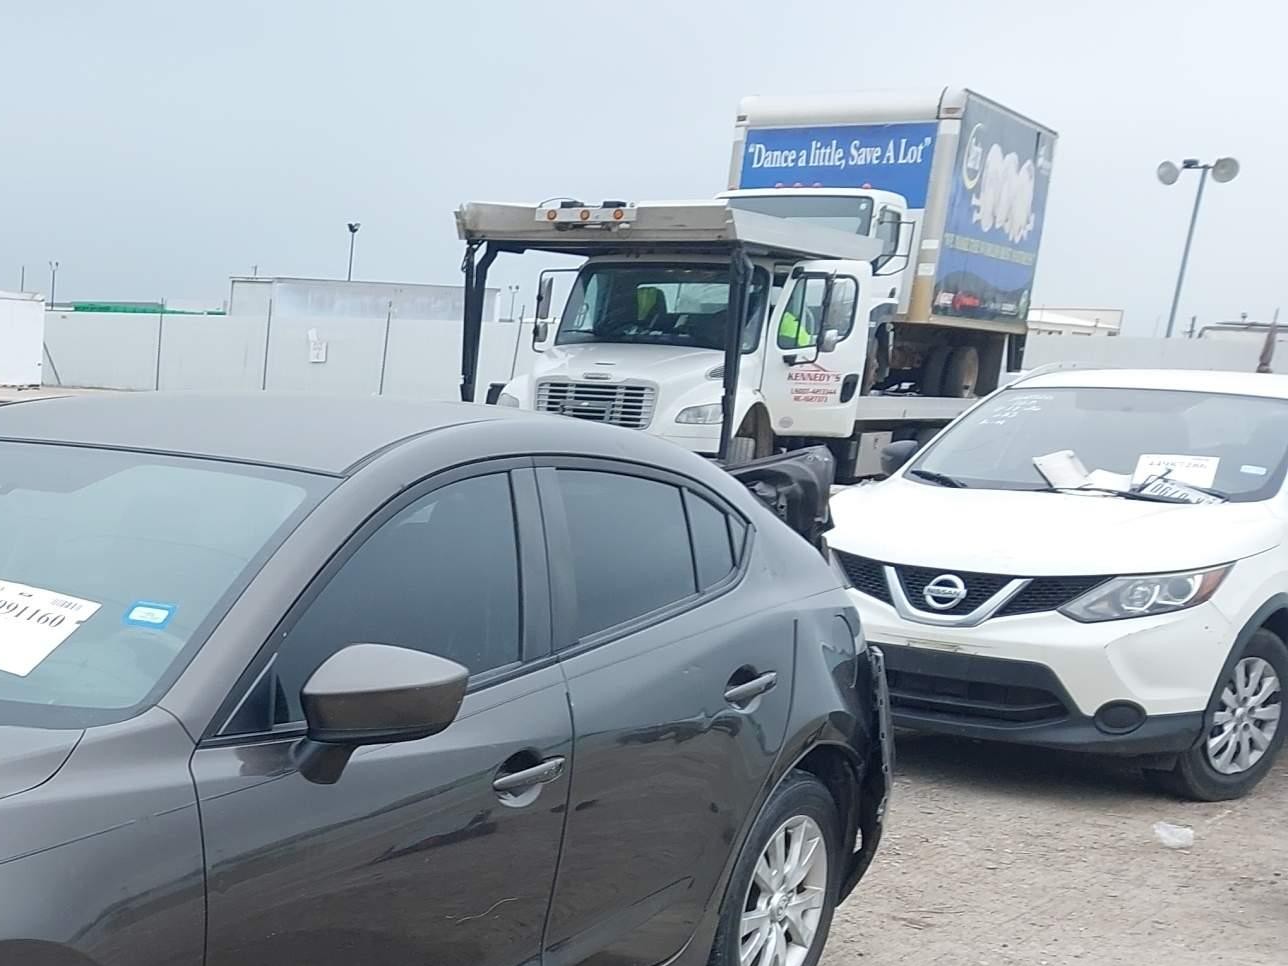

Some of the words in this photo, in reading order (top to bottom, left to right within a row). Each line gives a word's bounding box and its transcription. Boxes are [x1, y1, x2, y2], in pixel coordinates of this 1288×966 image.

[798, 149, 807, 167] a
[809, 140, 846, 169] little,
[849, 140, 882, 165] Save
[883, 140, 895, 164] A
[787, 372, 841, 382] KENNEDY'S
[925, 587, 962, 597] NISSAN
